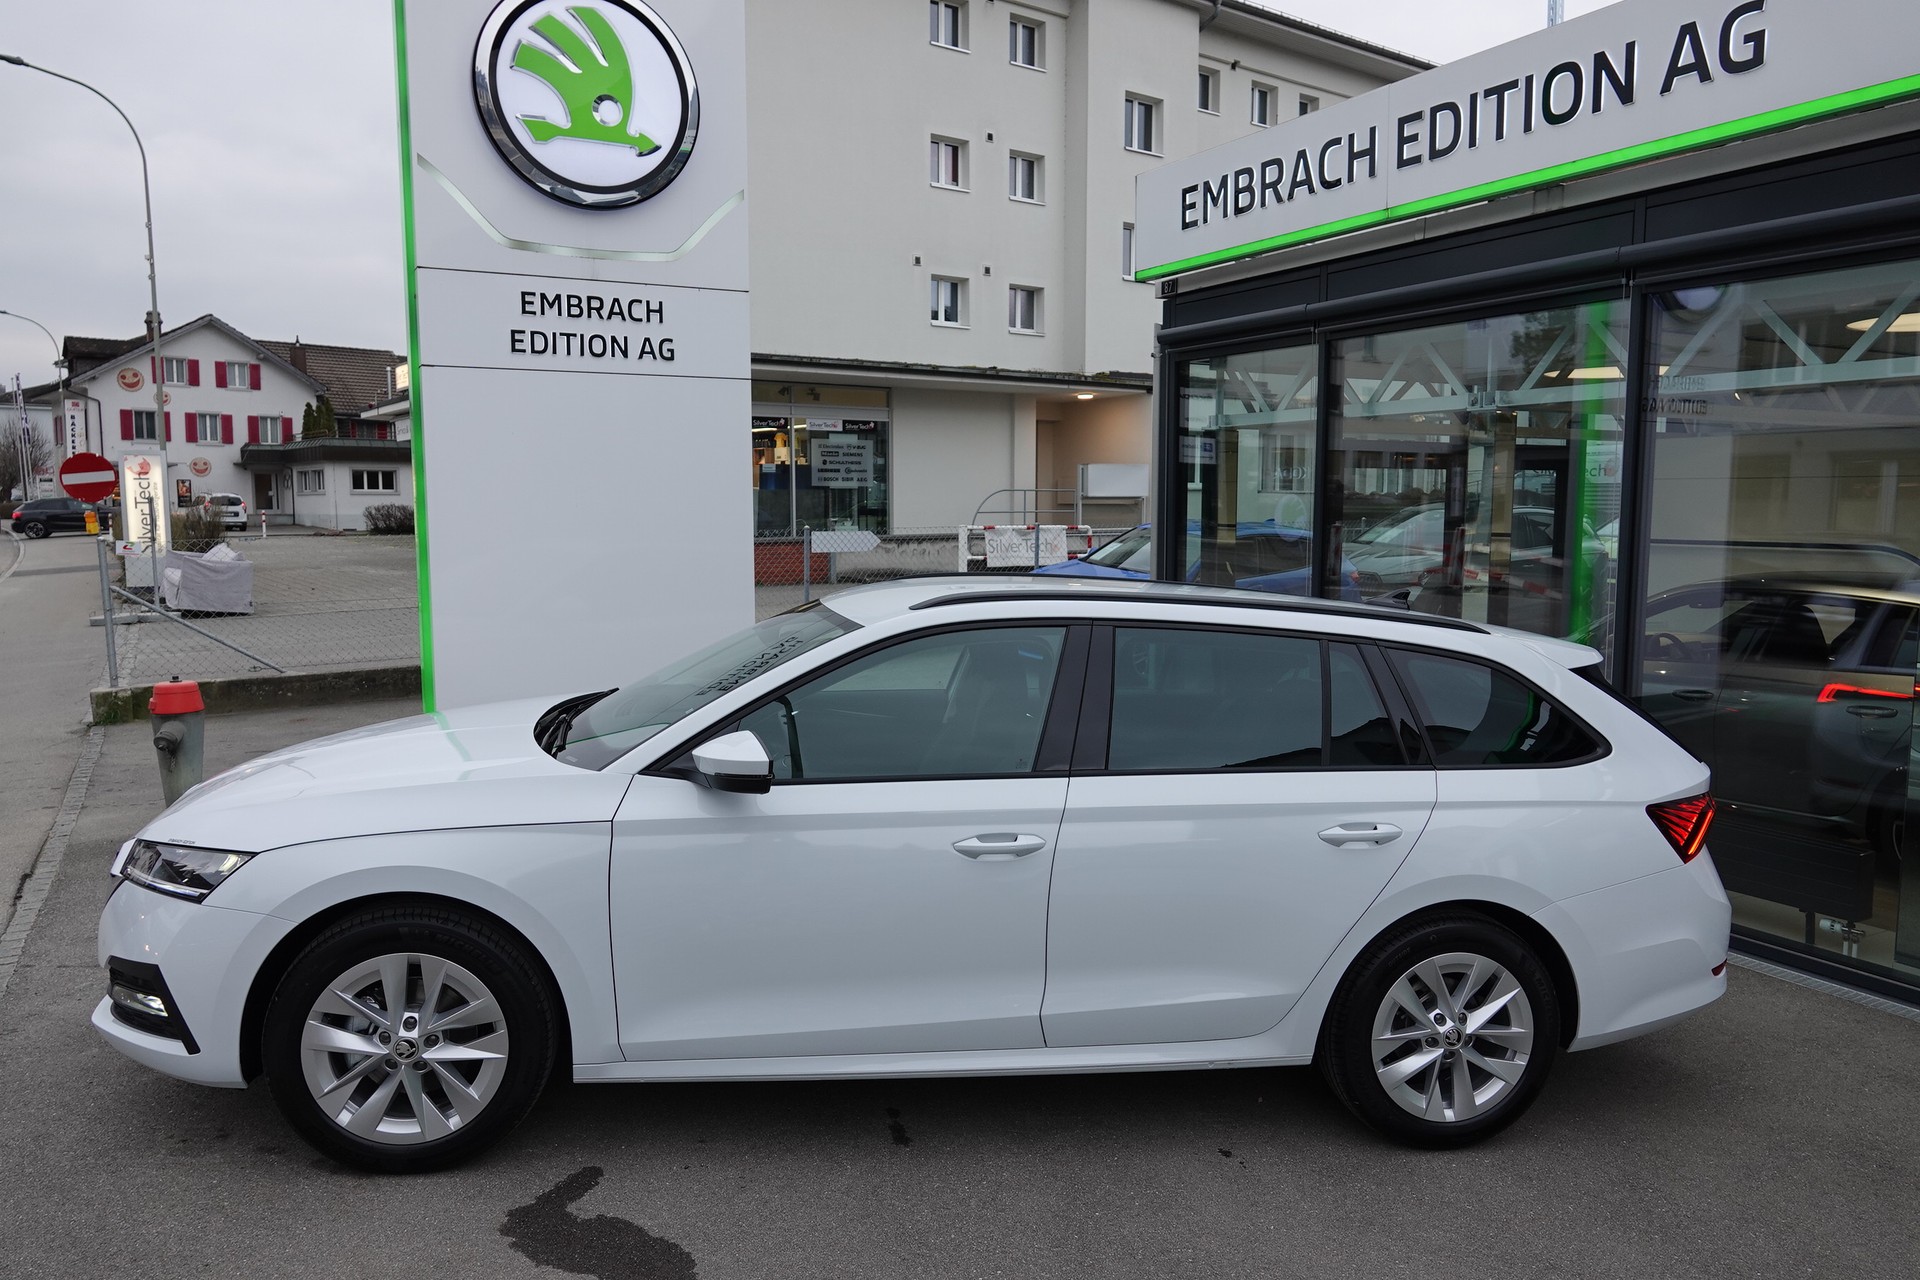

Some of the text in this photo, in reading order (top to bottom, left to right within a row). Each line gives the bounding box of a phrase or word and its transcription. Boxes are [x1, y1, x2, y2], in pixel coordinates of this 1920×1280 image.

[1181, 0, 1767, 231] EMBRACH EDITION AG
[1164, 281, 1173, 293] 87
[520, 290, 664, 324] EMBRACH
[510, 329, 675, 362] EDITION AG
